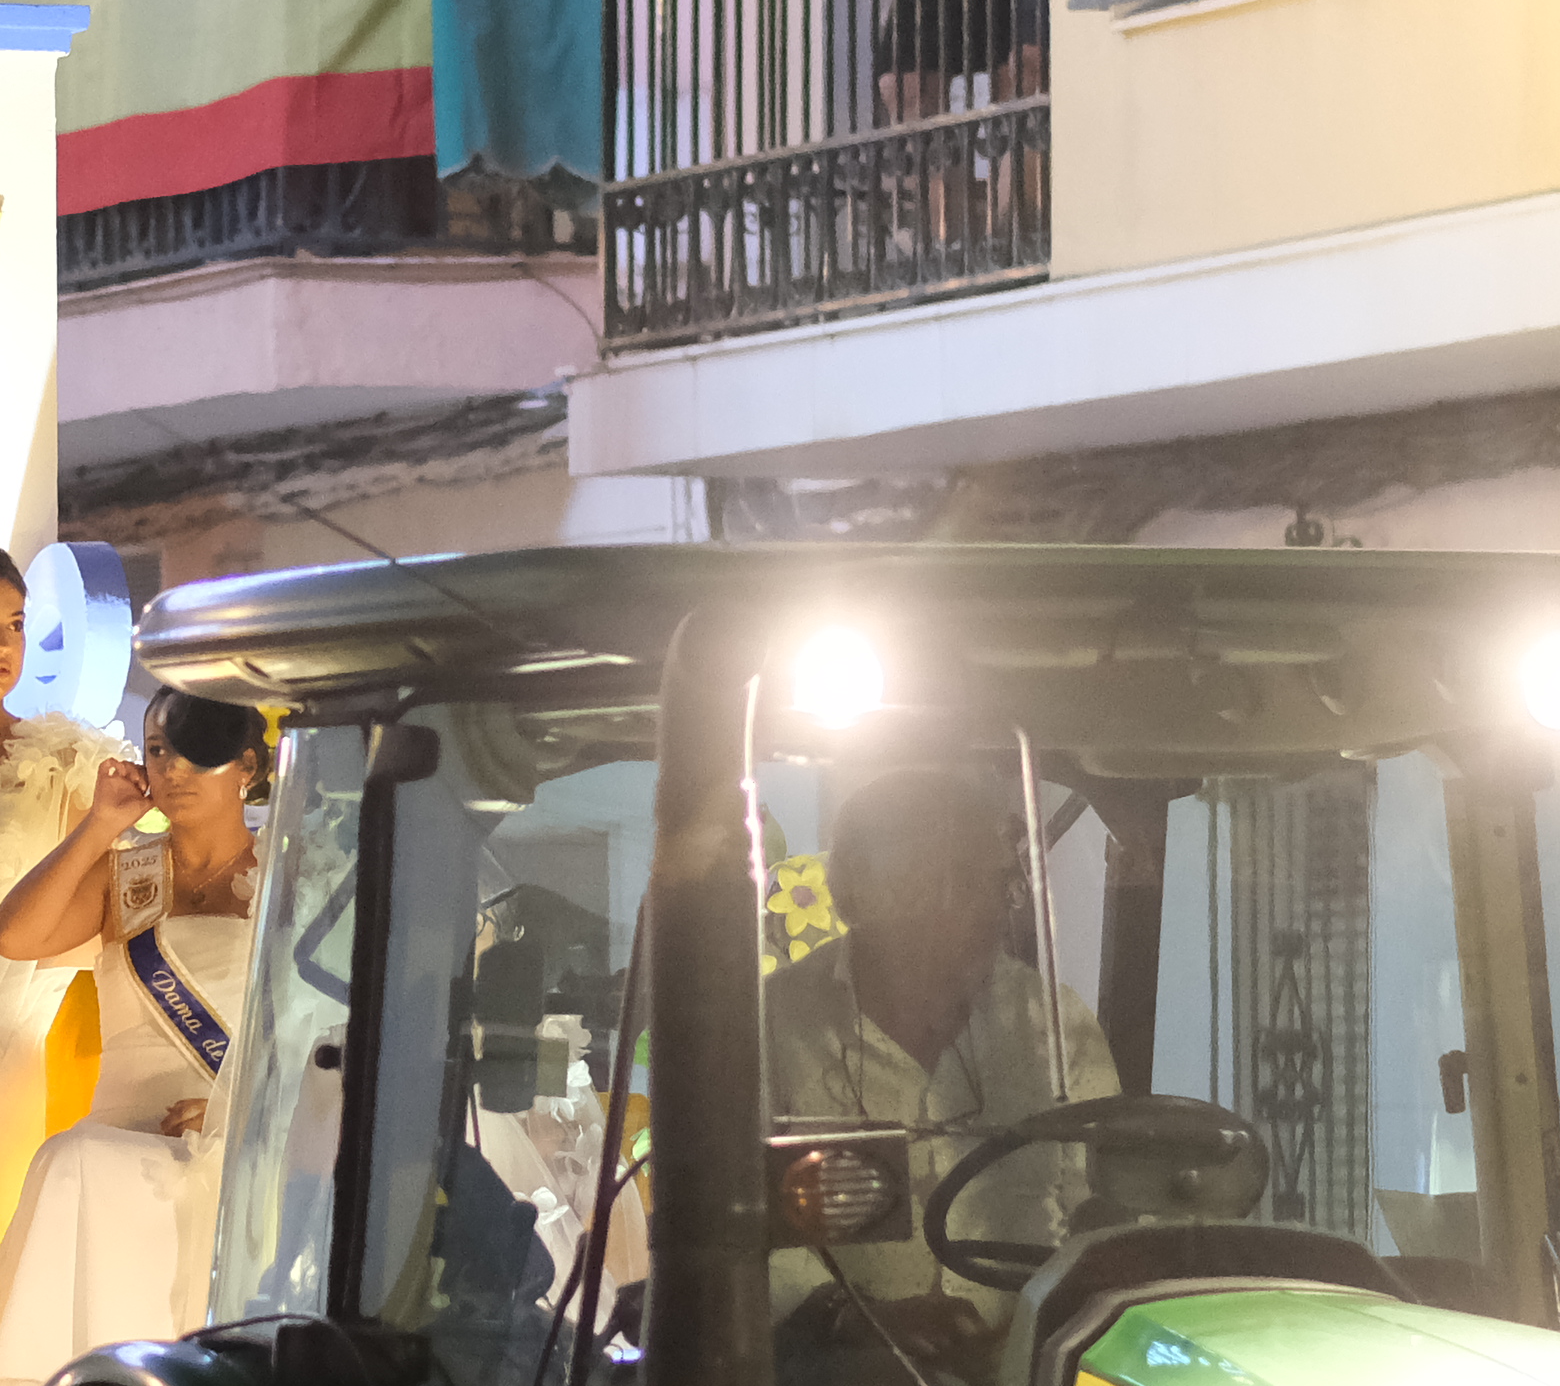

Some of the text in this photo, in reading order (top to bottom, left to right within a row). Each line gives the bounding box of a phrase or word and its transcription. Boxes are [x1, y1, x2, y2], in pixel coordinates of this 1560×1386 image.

[121, 854, 158, 872] 2025
[152, 970, 227, 1063] Dama de
